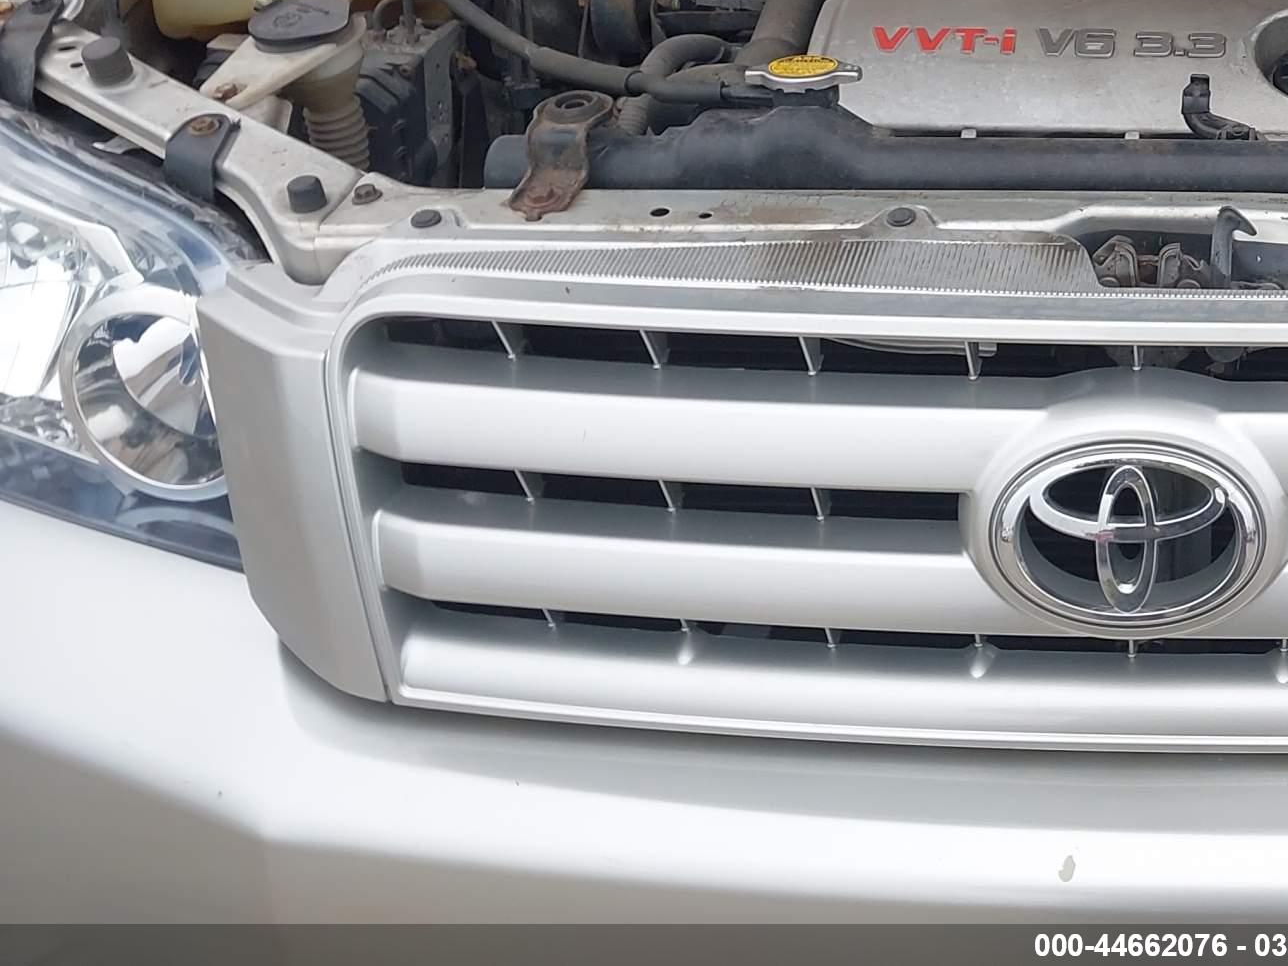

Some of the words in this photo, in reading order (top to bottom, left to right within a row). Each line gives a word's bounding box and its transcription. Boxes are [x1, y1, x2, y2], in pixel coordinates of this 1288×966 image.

[872, 25, 1017, 54] VVT-i
[1036, 26, 1117, 59] V6
[1132, 31, 1227, 59] 3.3
